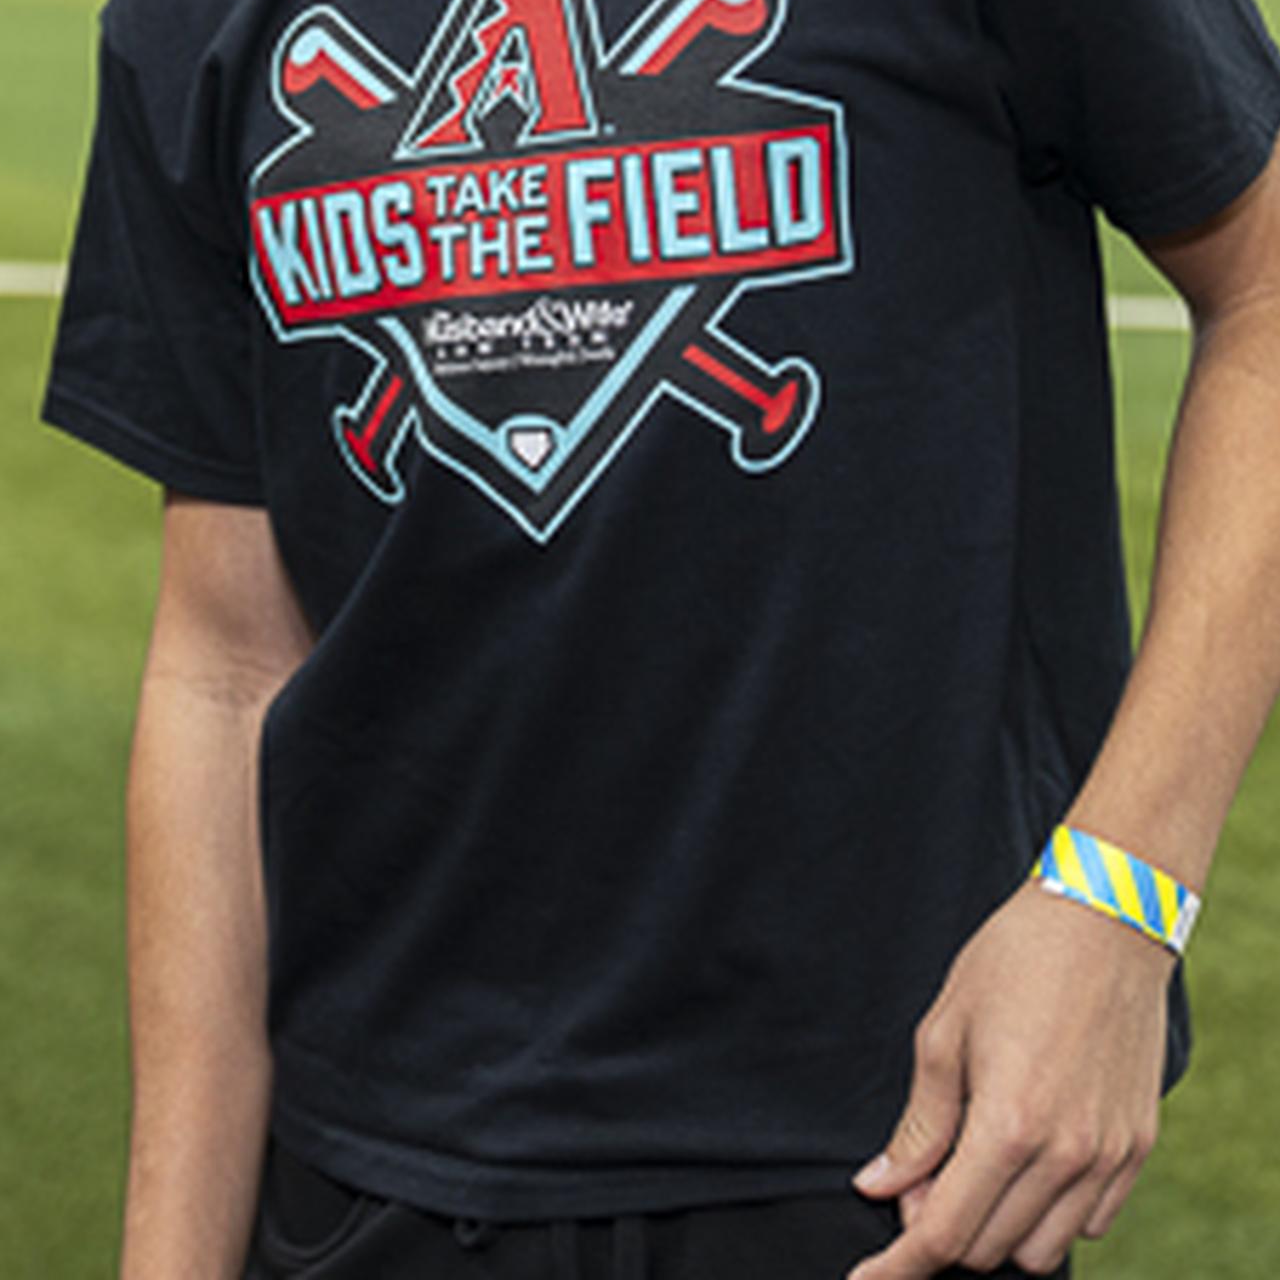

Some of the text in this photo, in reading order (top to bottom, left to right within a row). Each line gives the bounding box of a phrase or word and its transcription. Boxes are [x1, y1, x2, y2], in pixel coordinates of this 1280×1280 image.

[426, 164, 549, 218] TAKE
[564, 135, 825, 268] FIELD
[257, 181, 424, 306] KIDS
[429, 216, 554, 281] THE
